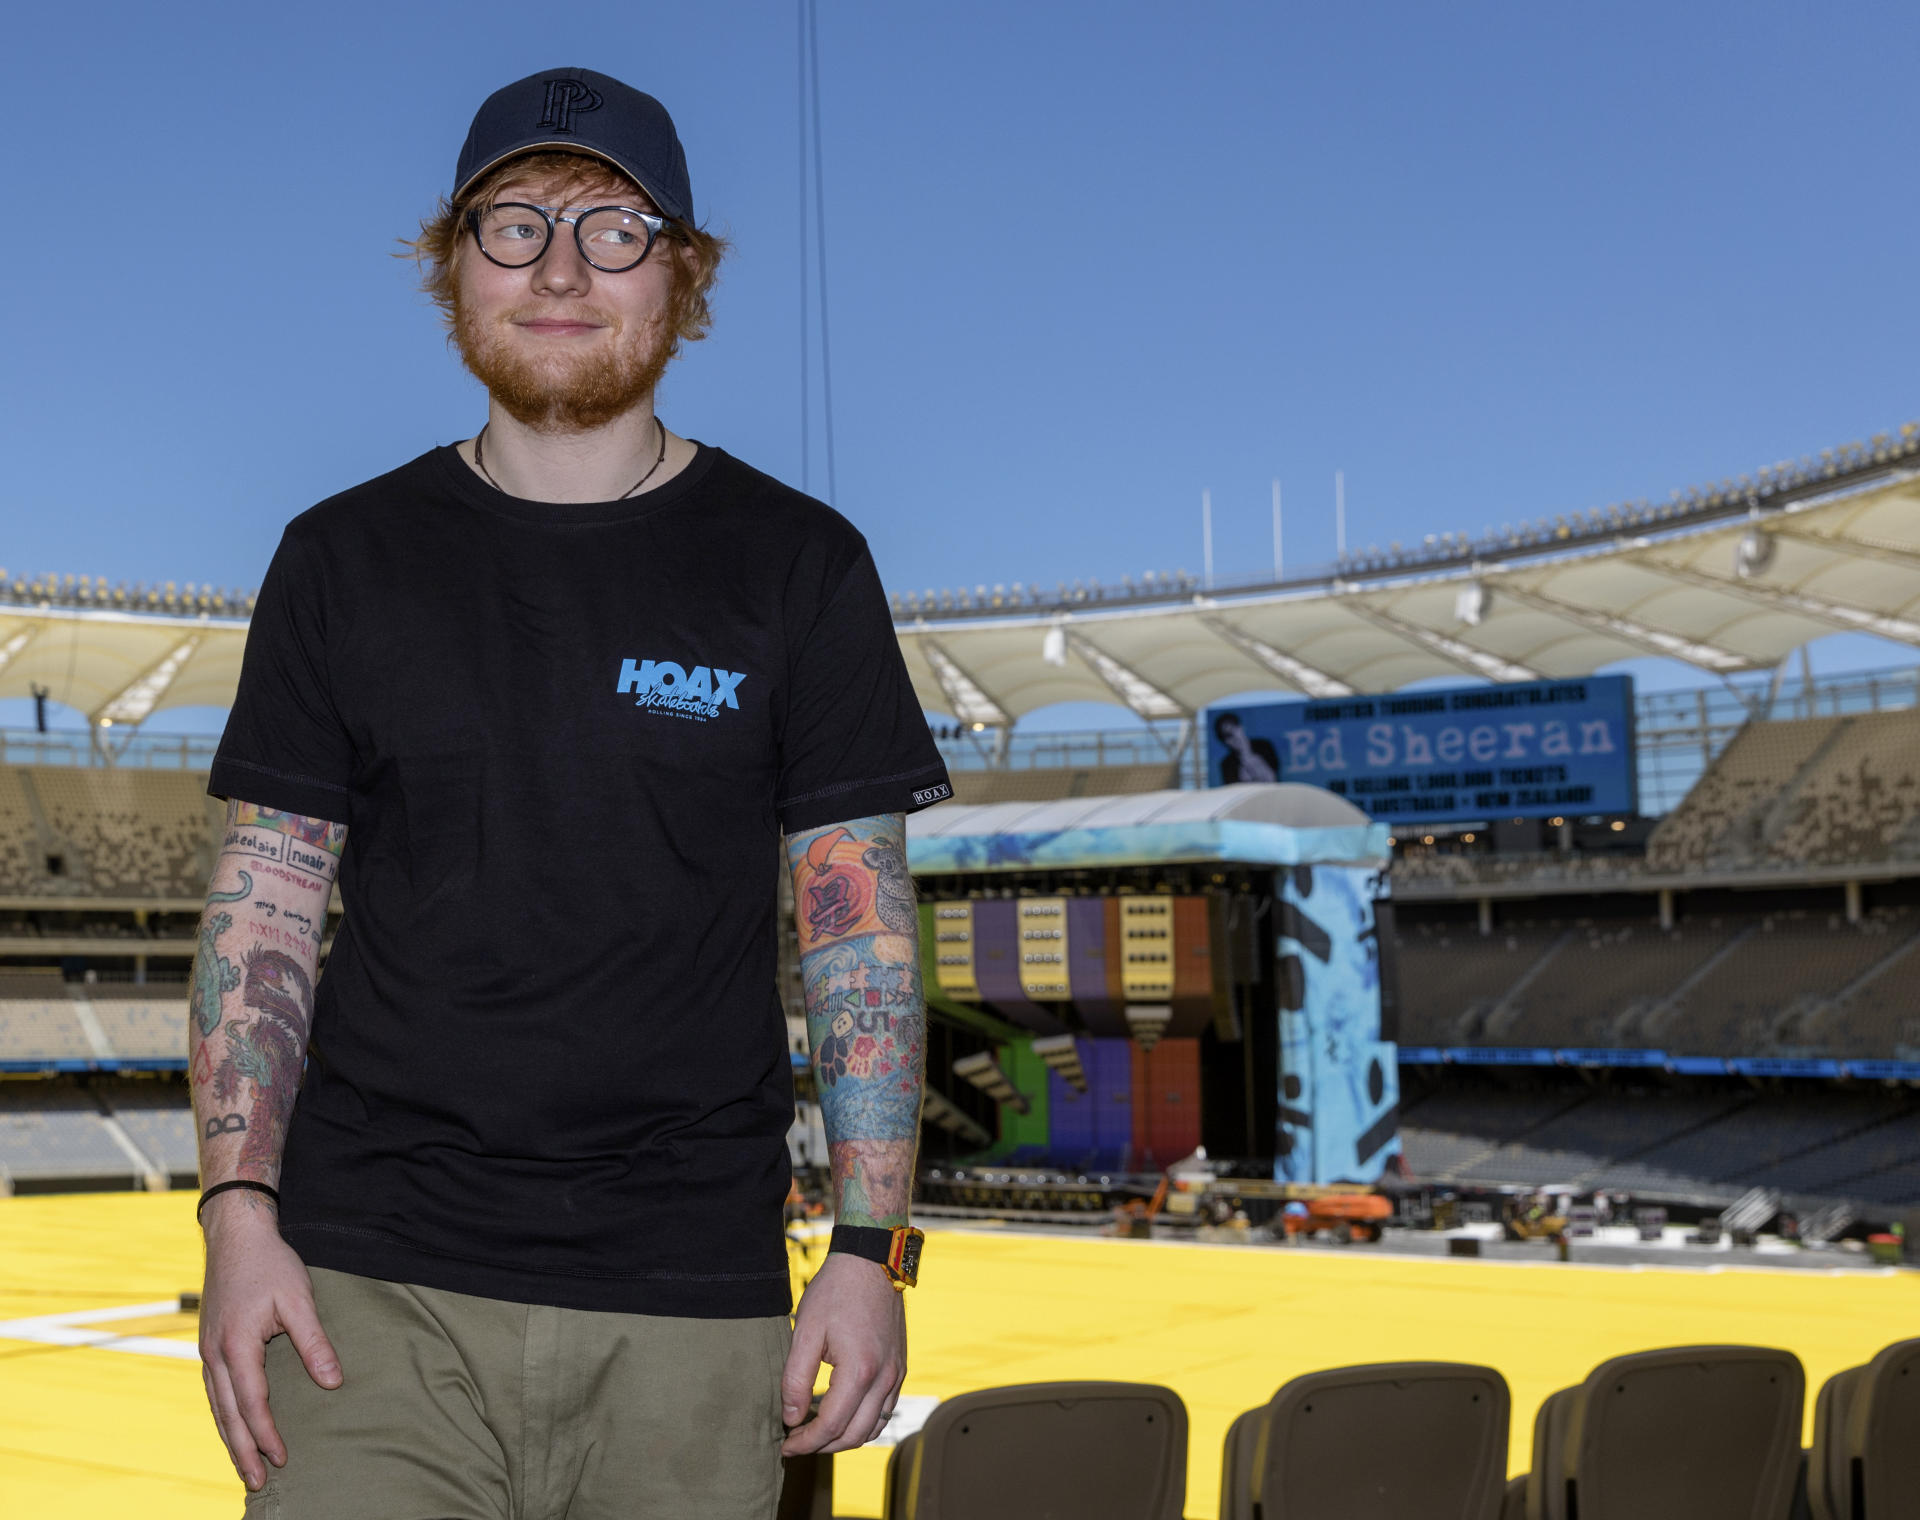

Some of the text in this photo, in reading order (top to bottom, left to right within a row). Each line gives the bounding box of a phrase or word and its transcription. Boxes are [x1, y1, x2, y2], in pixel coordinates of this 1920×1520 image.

[616, 658, 747, 710] HOAX
[648, 709, 674, 717] ROLLING
[675, 712, 693, 721] SINCE
[1285, 719, 1616, 773] Ed Sheeran
[914, 784, 949, 804] HOAX
